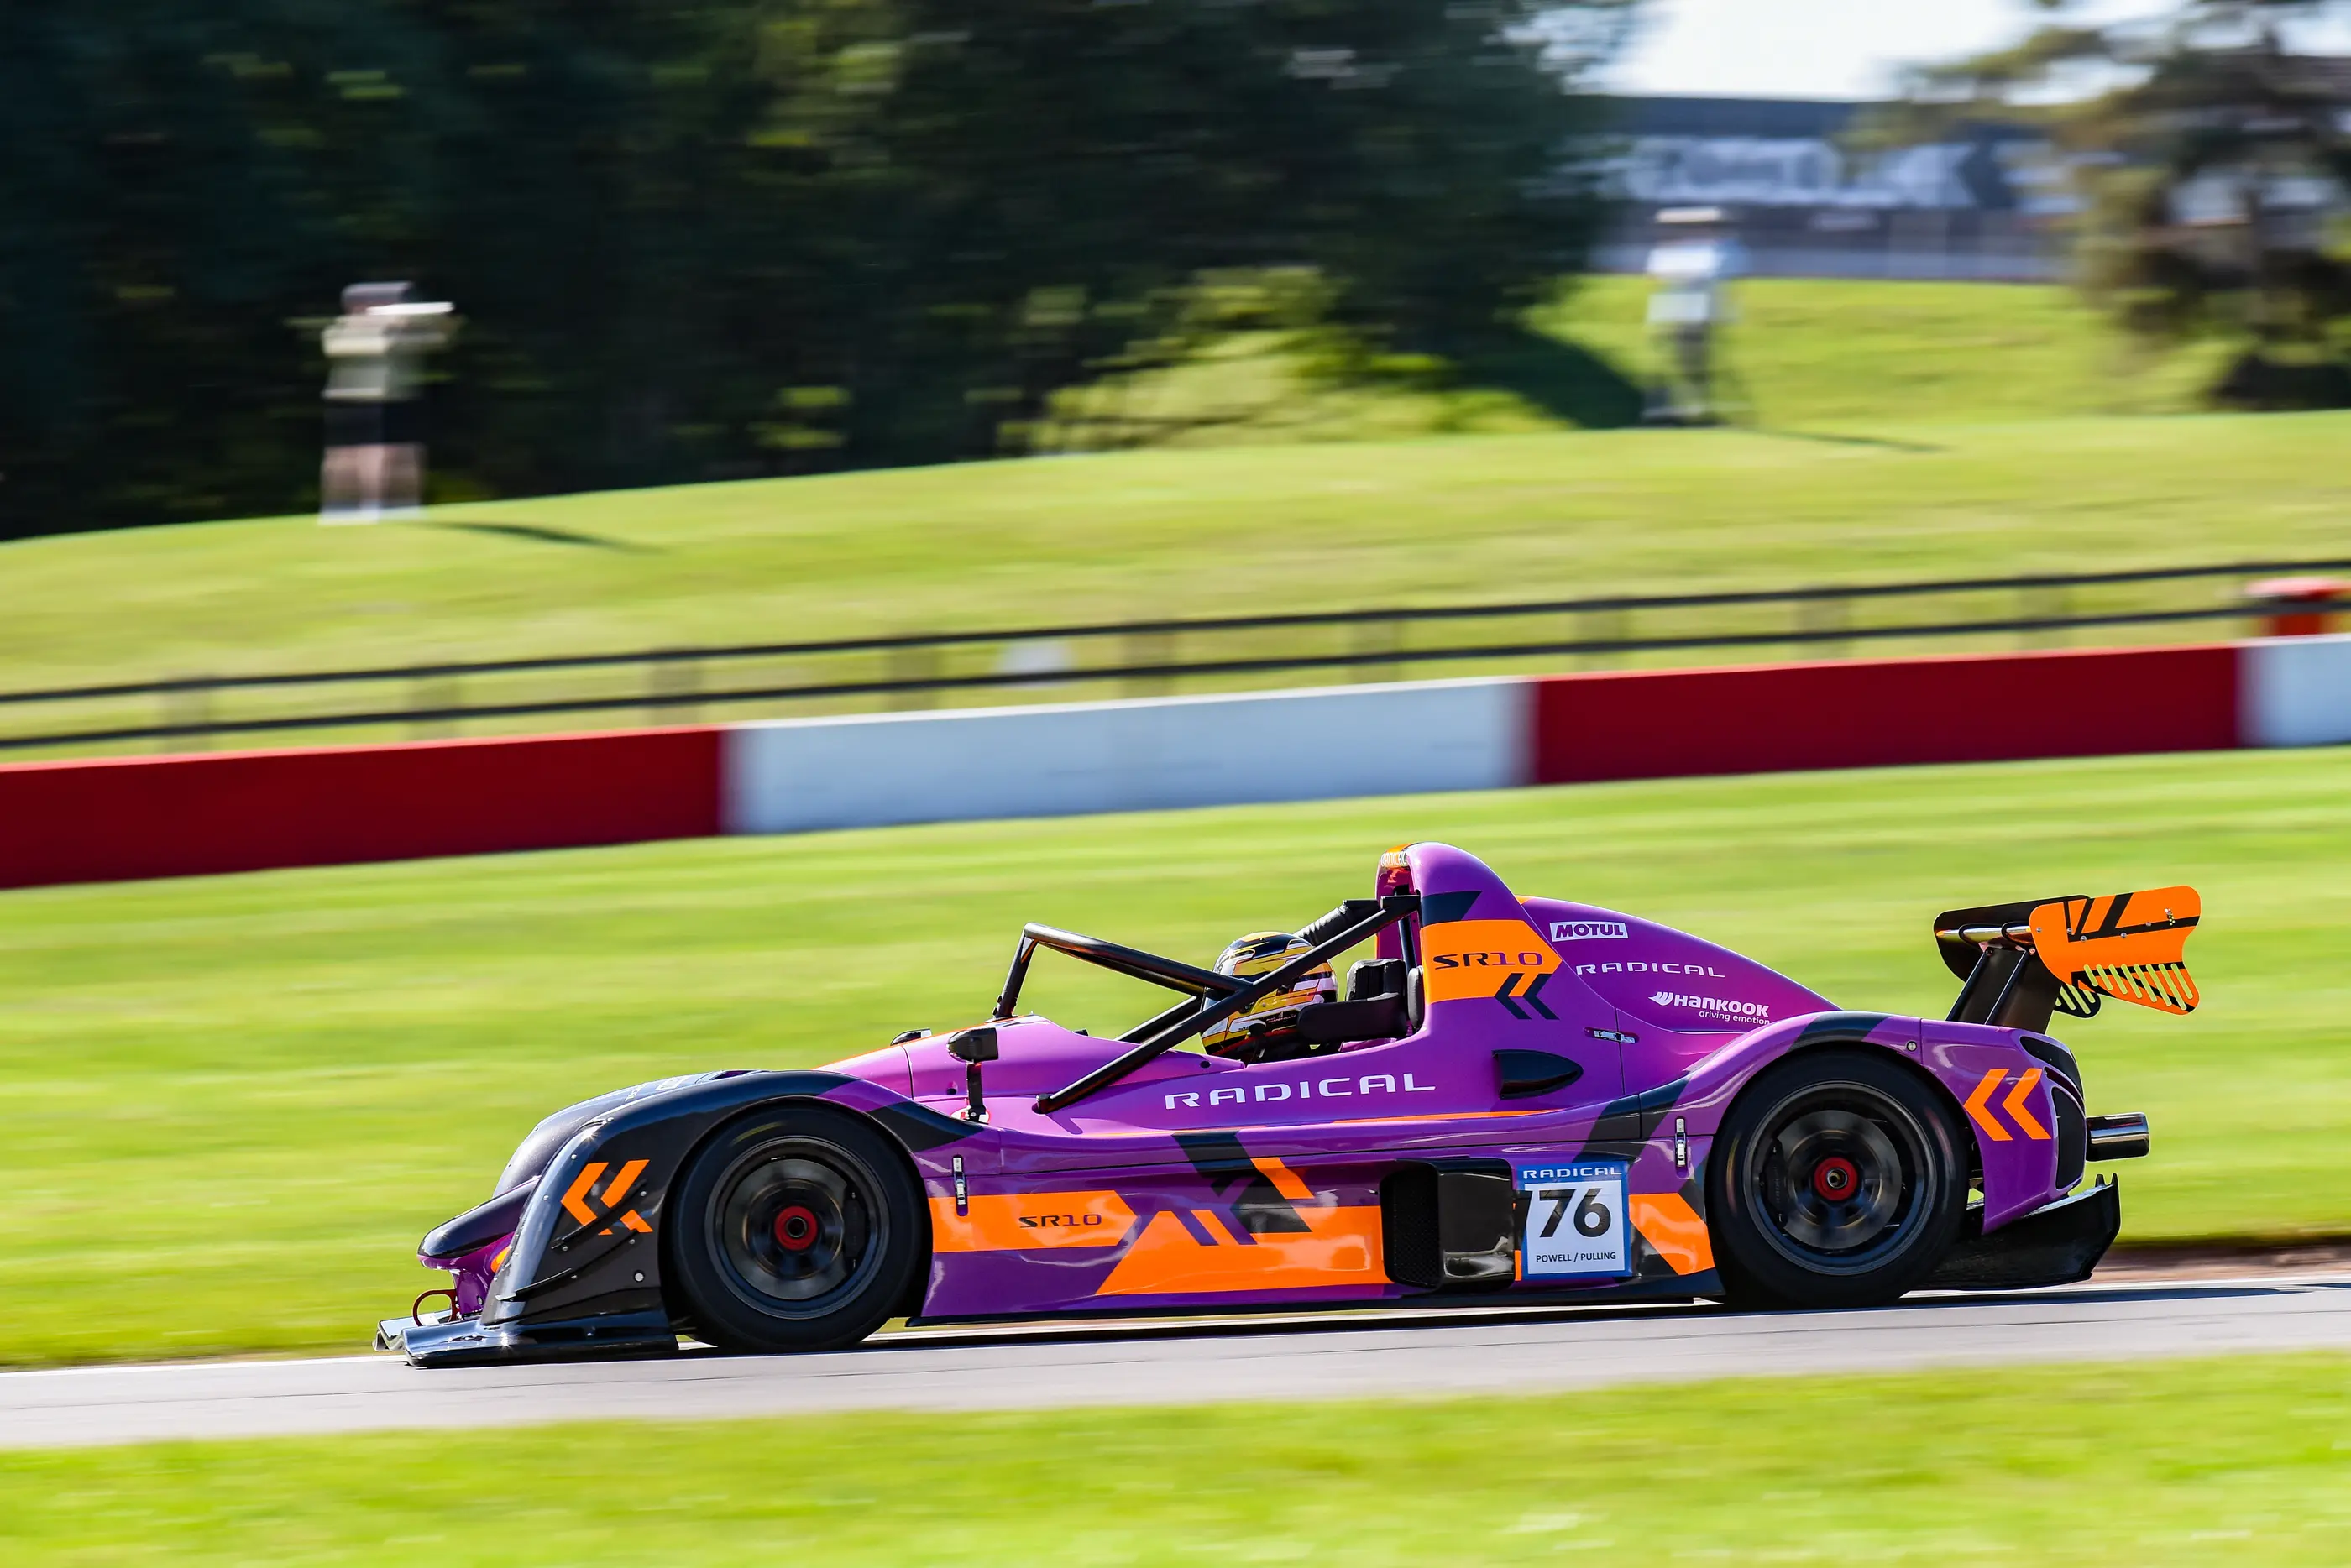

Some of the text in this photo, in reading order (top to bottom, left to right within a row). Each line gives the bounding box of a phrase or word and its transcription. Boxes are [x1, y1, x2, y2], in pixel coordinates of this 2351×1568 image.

[1555, 923, 1624, 938] MOTUL
[1432, 951, 1543, 970] SR10
[1575, 961, 1726, 978] RADICAL
[1699, 1010, 1771, 1025] driving emotion
[1165, 1073, 1436, 1110] RADICAL
[1522, 1167, 1622, 1179] RADICAL
[1539, 1188, 1611, 1238] 76
[1018, 1214, 1102, 1228] SR10
[1536, 1252, 1616, 1262] POWELL / PULLING
